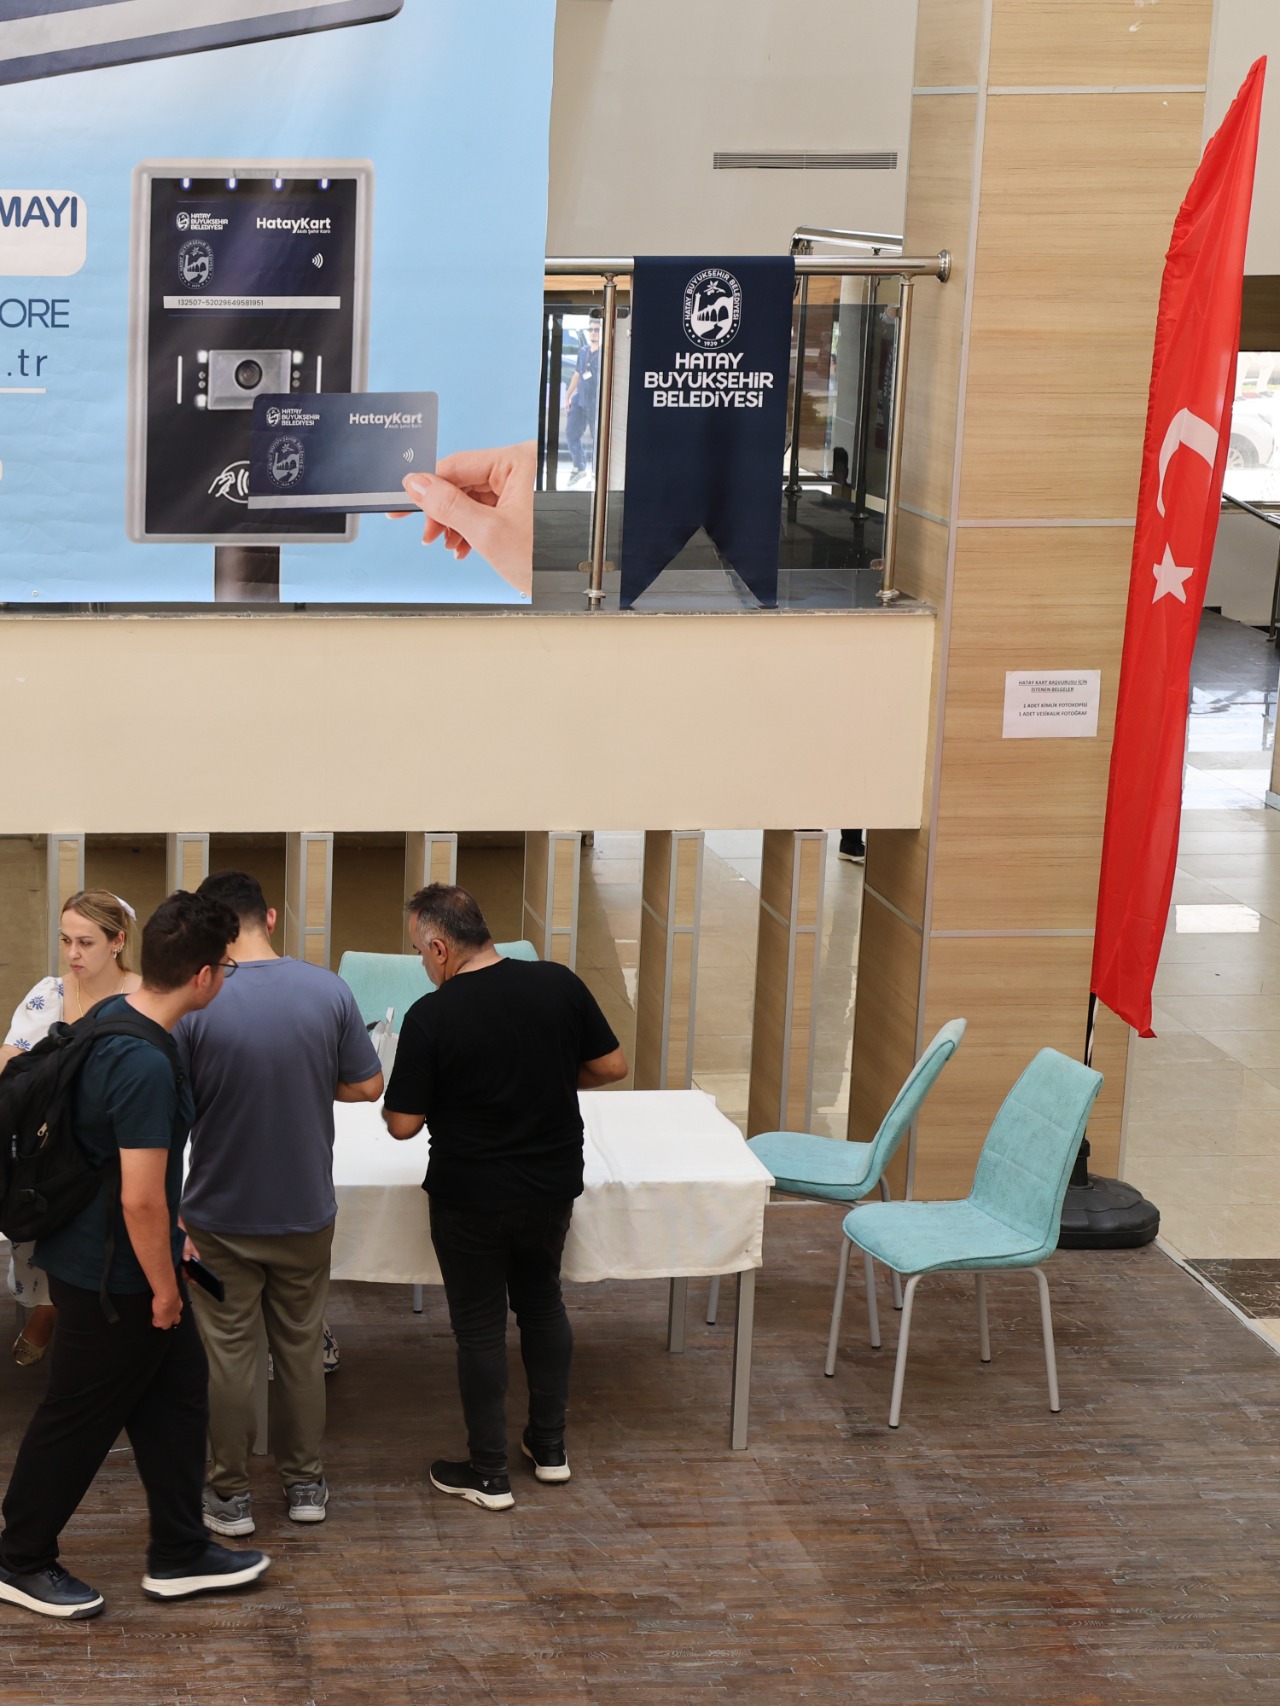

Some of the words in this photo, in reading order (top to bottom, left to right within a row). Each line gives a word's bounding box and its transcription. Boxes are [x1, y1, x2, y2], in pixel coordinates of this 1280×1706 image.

[256, 217, 331, 234] HatayKart
[675, 353, 744, 369] HATAY
[644, 371, 774, 390] BÜYÜKŞEHİR
[653, 391, 763, 408] BELEDİYESİ
[349, 412, 423, 429] HatayKart
